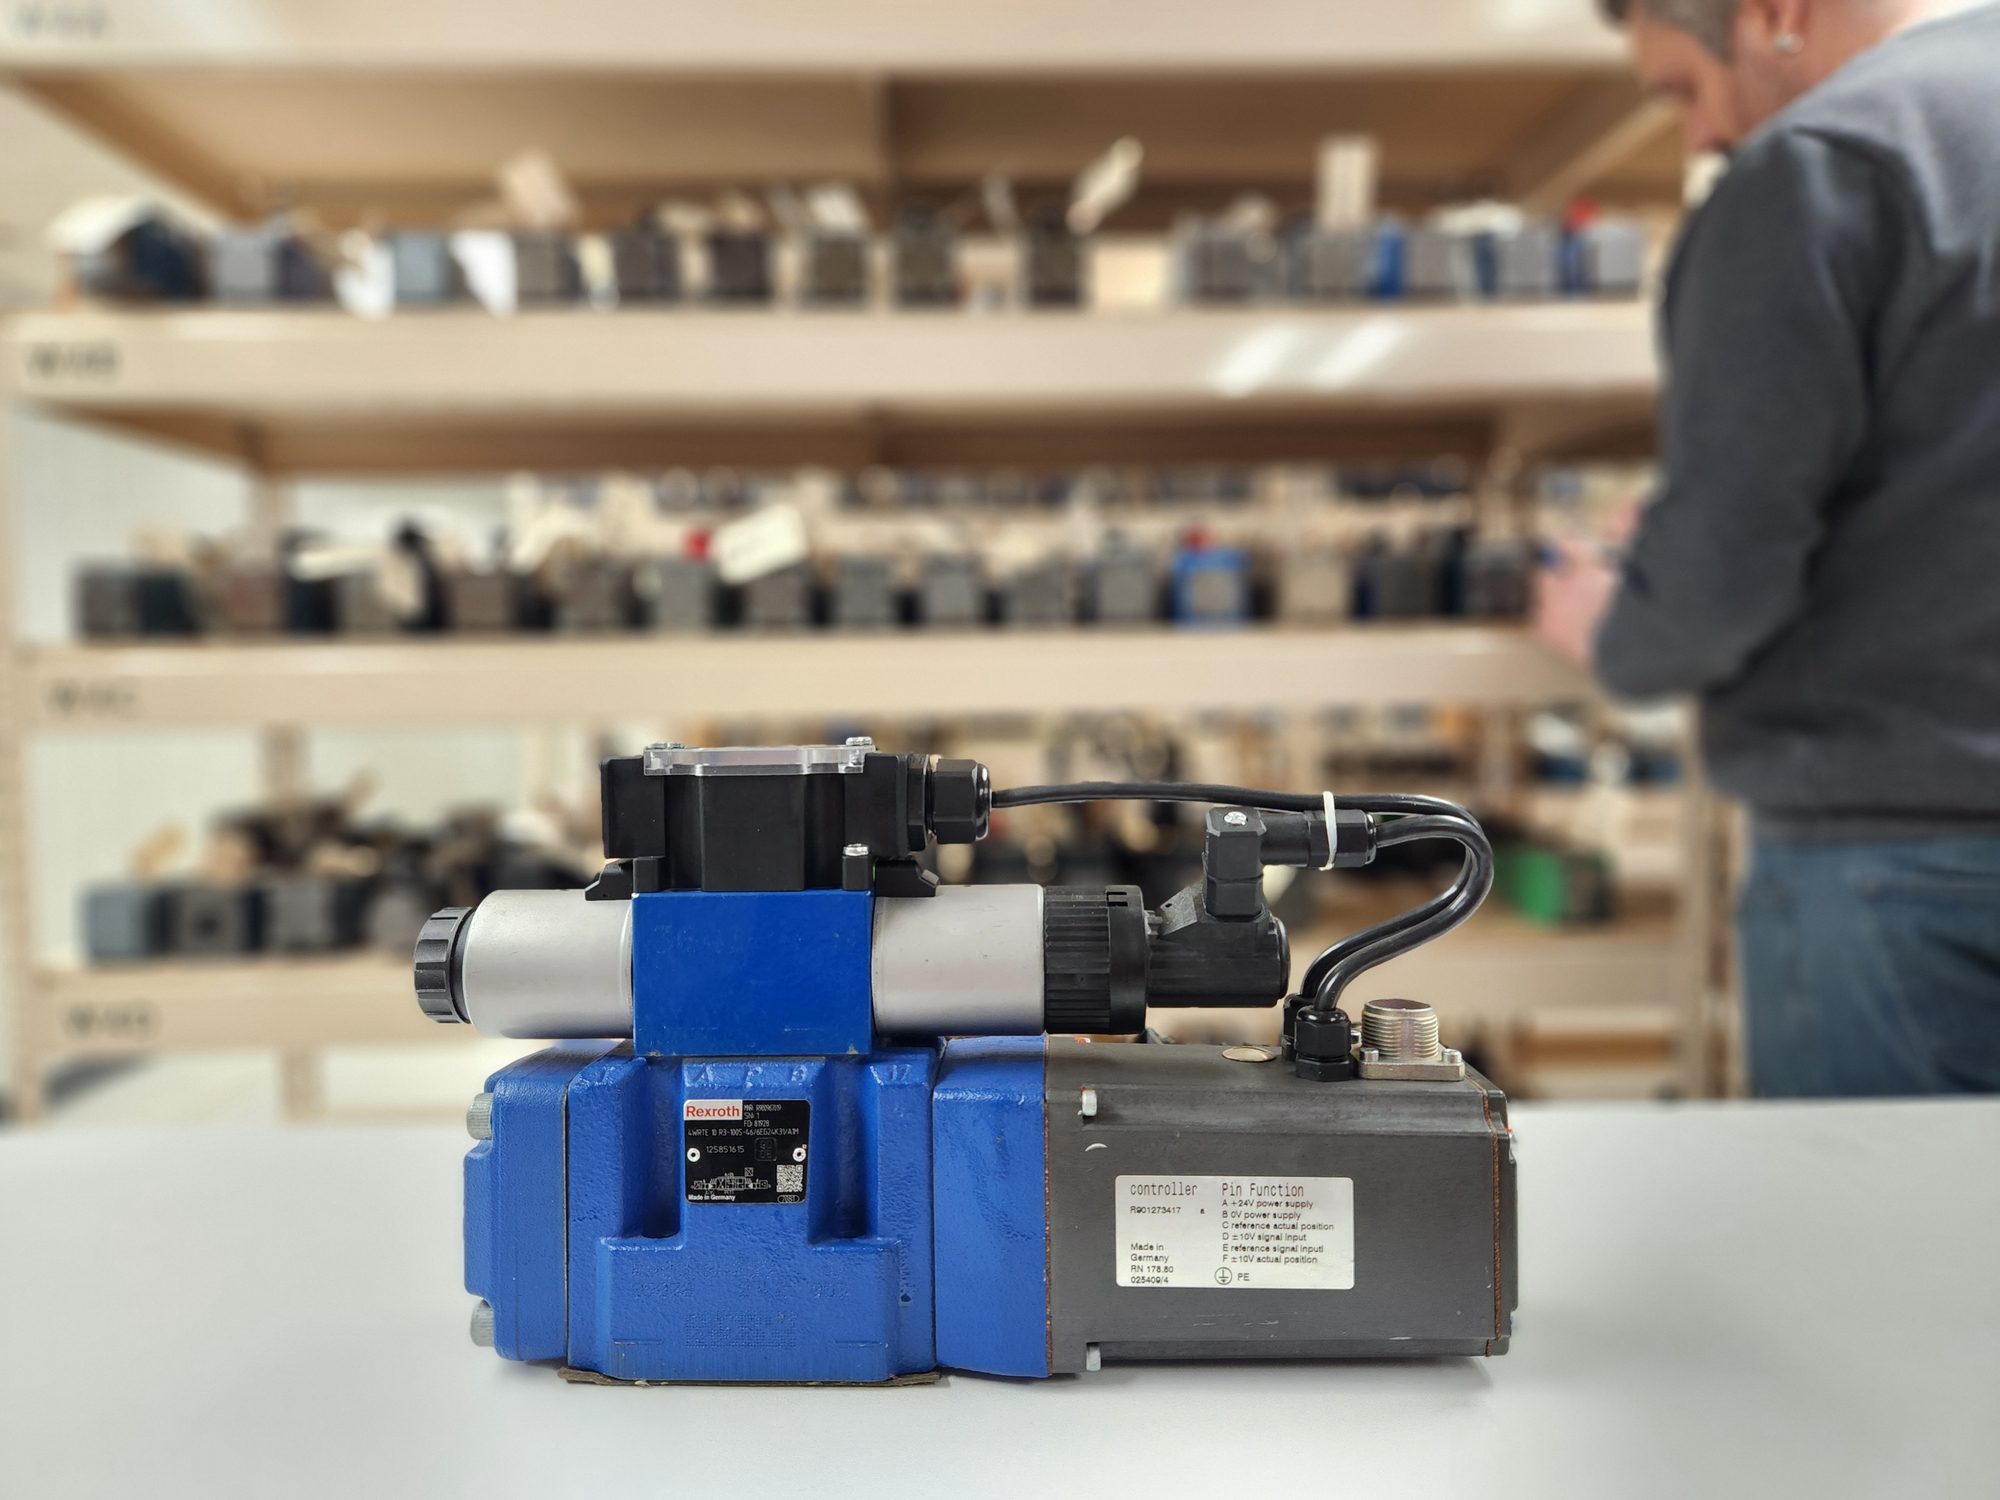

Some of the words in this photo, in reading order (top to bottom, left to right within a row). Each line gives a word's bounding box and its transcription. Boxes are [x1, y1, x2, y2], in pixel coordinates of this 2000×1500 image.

[686, 1105, 740, 1117] Rexroth
[688, 1128, 709, 1136] 4WRTE
[1130, 1181, 1198, 1196] controller
[1221, 1182, 1242, 1197] Pin
[1249, 1182, 1304, 1197] Function
[710, 1193, 736, 1202] Germany
[1256, 1201, 1283, 1209] power
[1285, 1200, 1313, 1209] supply
[1130, 1205, 1181, 1214] R901273417
[1244, 1212, 1271, 1220] power
[1273, 1211, 1301, 1220] supply
[1222, 1221, 1229, 1229] C
[1301, 1222, 1334, 1231] position
[1257, 1233, 1283, 1242] signal
[1285, 1233, 1307, 1242] input
[1130, 1243, 1154, 1251] Made
[1156, 1243, 1164, 1251] in
[1230, 1244, 1270, 1252] reference
[1273, 1245, 1298, 1254] signal
[1130, 1253, 1169, 1263] Germany
[1256, 1255, 1282, 1263] actual
[1284, 1256, 1318, 1265] position
[1130, 1265, 1143, 1273] RN
[1237, 1273, 1250, 1281] PE
